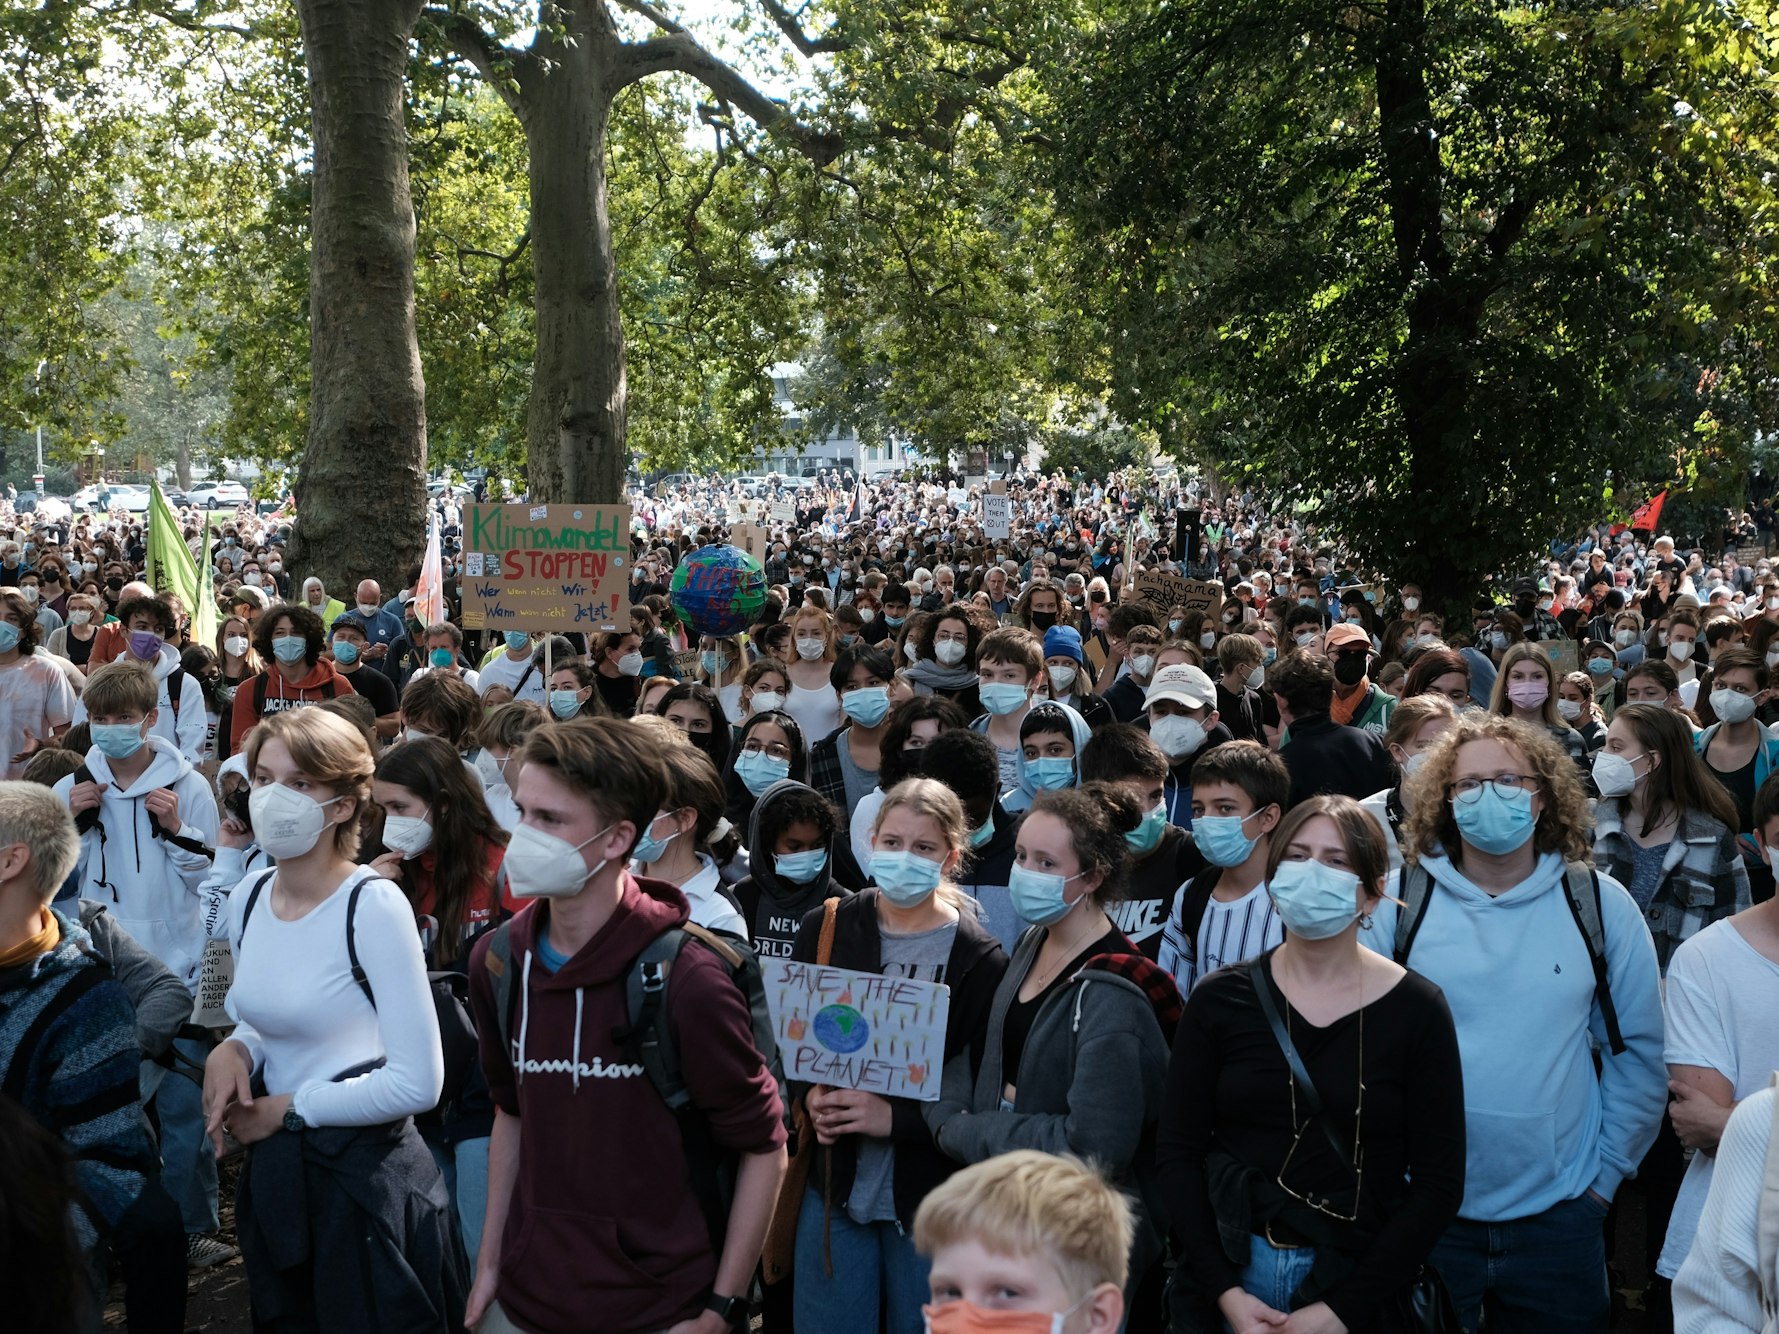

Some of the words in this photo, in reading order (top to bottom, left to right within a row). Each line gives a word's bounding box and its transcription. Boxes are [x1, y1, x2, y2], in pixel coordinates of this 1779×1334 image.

[986, 498, 1006, 507] VOTE
[475, 581, 501, 598] Wer
[530, 586, 557, 597] nicht
[1135, 570, 1218, 598] Pachamama
[483, 600, 515, 619] Wann
[542, 606, 567, 618] nicht
[264, 697, 285, 713] JACK
[1103, 898, 1164, 932] NIKE
[768, 916, 801, 933] NEW
[202, 959, 220, 967] UND
[202, 967, 214, 975] AN
[201, 975, 228, 984] ALLEN
[201, 983, 232, 992] ANDER
[777, 962, 843, 995] SAVE
[856, 976, 925, 1007] THE
[201, 1001, 224, 1010] AUCH
[794, 1045, 909, 1092] PLANET
